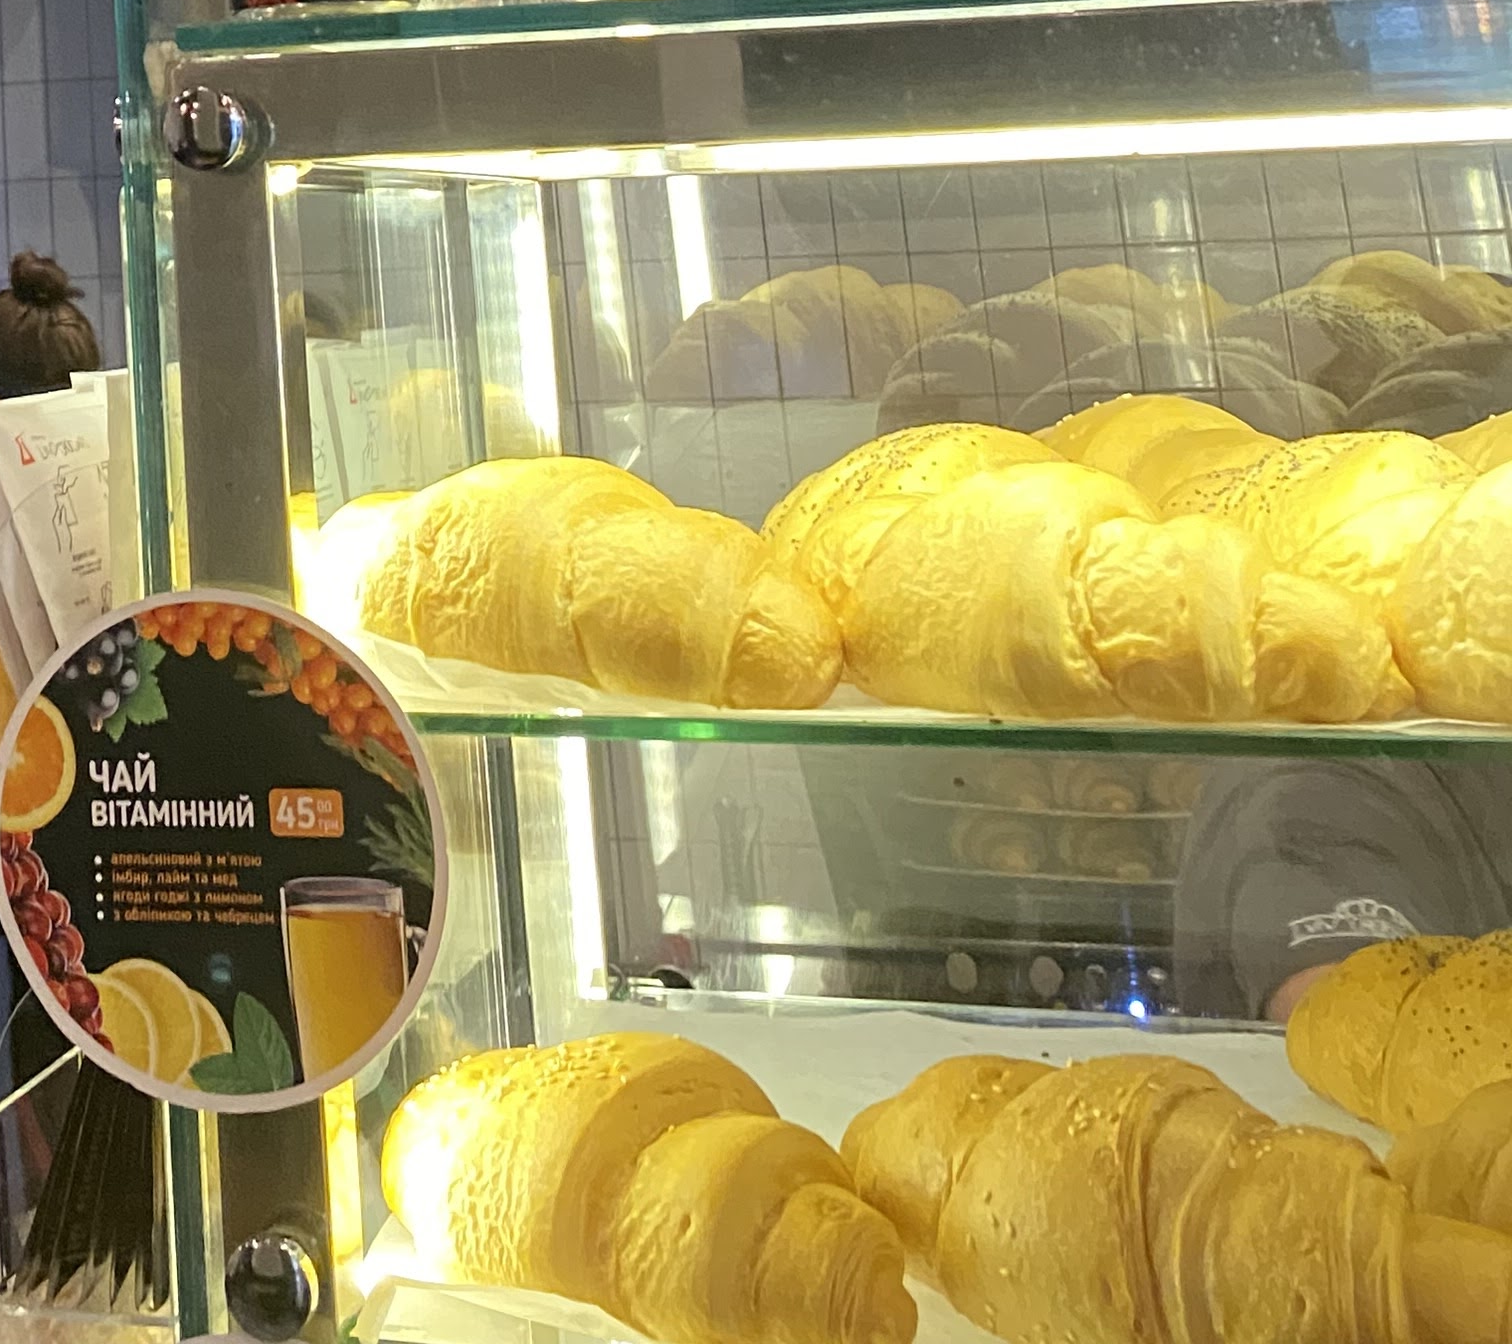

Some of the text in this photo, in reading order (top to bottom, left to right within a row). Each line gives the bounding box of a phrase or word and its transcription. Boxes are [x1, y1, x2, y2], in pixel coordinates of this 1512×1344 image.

[89, 752, 156, 793] ЧАЙ
[91, 794, 316, 829] ВІТАМІННИЙ 45
